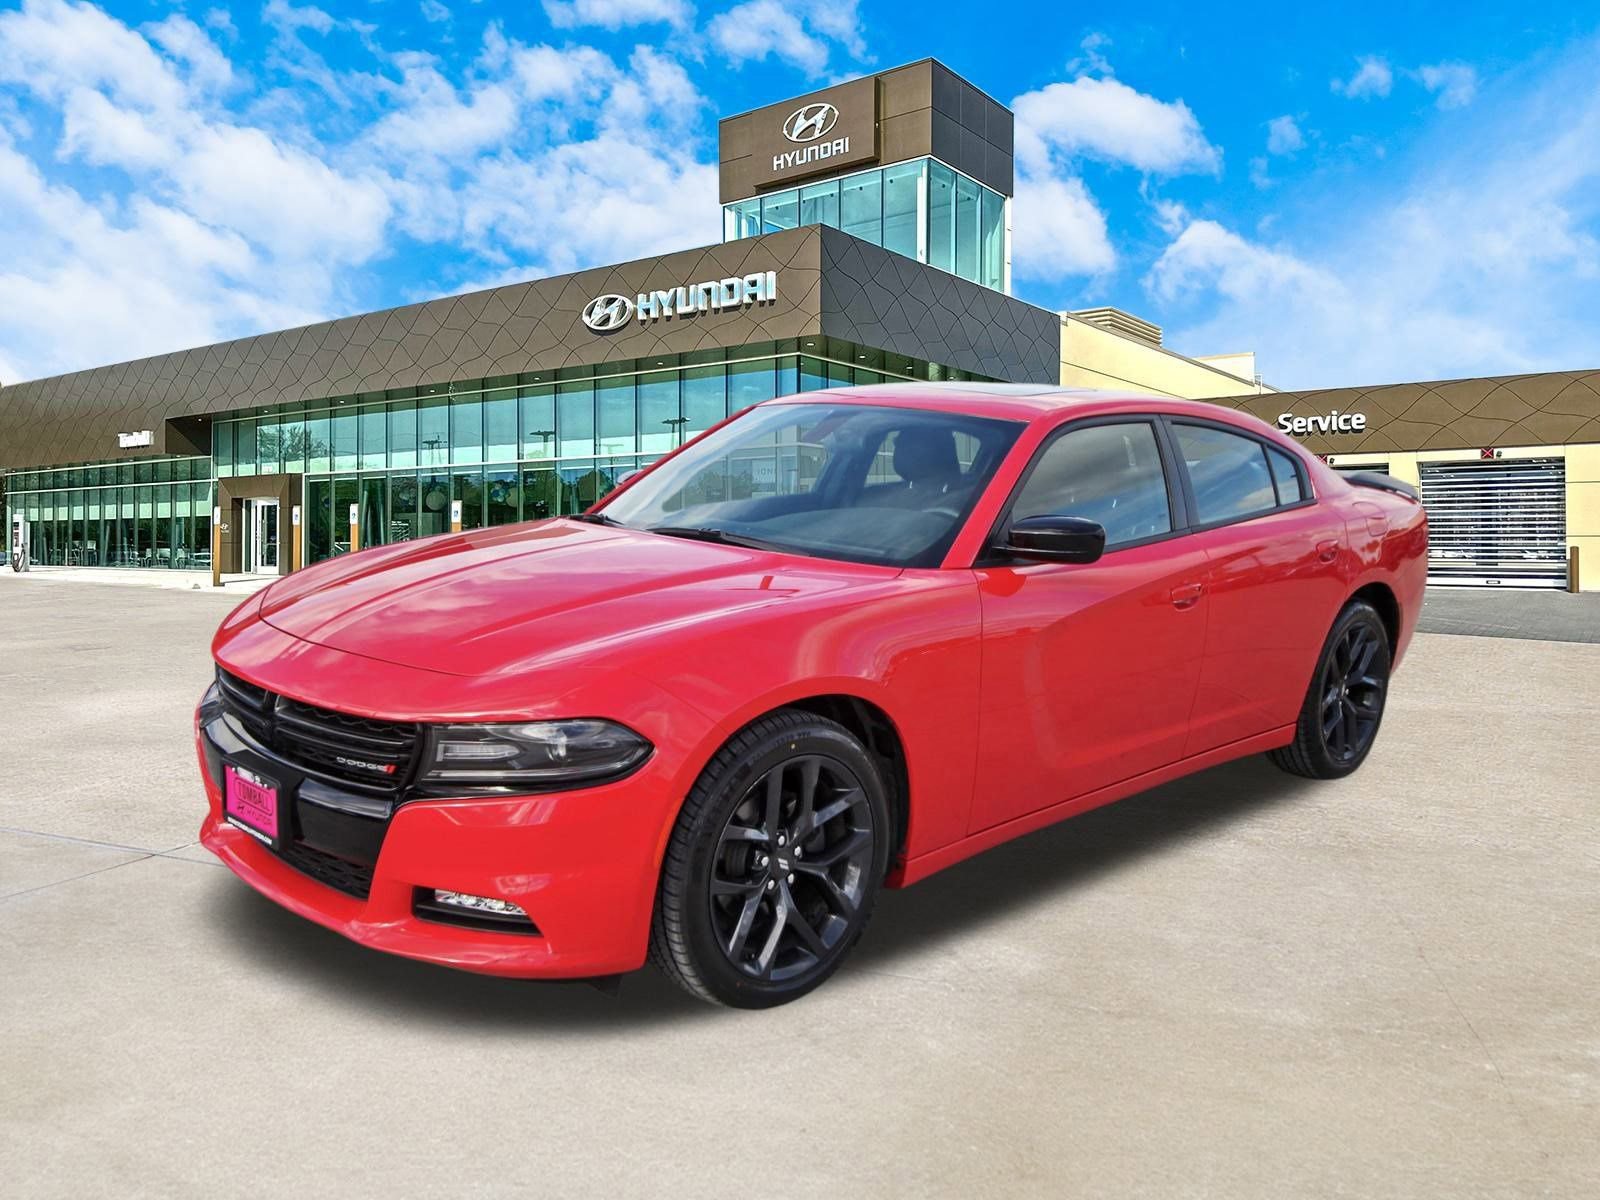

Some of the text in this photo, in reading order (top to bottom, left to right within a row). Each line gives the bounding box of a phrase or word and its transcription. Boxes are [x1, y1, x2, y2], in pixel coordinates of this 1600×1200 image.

[773, 137, 849, 170] HYUNDAI
[637, 270, 777, 321] HYUNDAI
[1278, 410, 1366, 433] Service
[336, 756, 388, 772] DODGE
